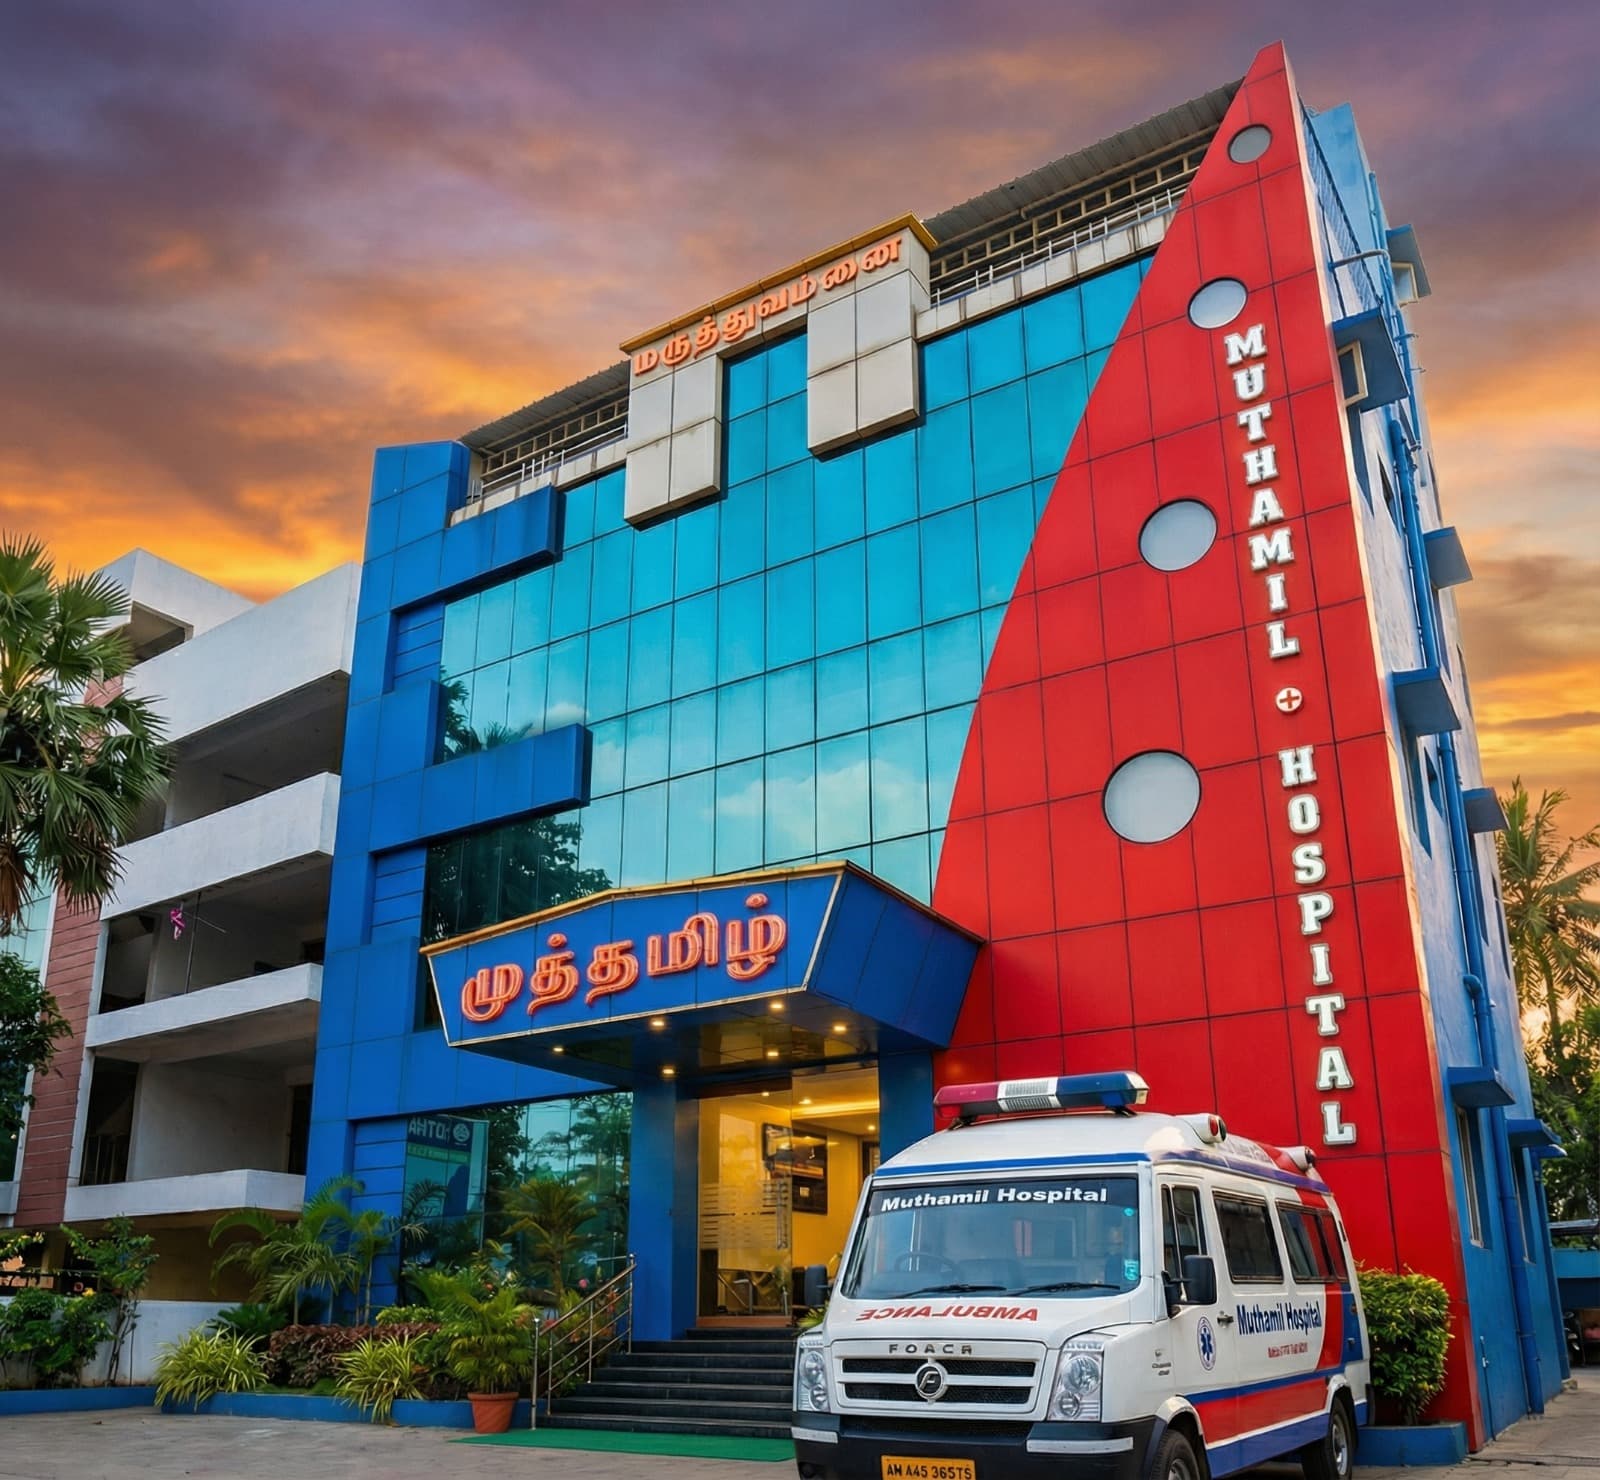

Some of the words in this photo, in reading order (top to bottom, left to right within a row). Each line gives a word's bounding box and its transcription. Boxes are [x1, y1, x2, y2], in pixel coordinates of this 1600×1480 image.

[1223, 323, 1300, 659] MUTHAMIL
[1278, 744, 1357, 1146] HOSPITAL
[461, 892, 788, 1022] முத்தமிழ்
[881, 1189, 989, 1212] Muthamil
[997, 1187, 1108, 1204] Hospital
[1236, 1303, 1286, 1336] Muthamil
[1286, 1300, 1322, 1336] Hospital
